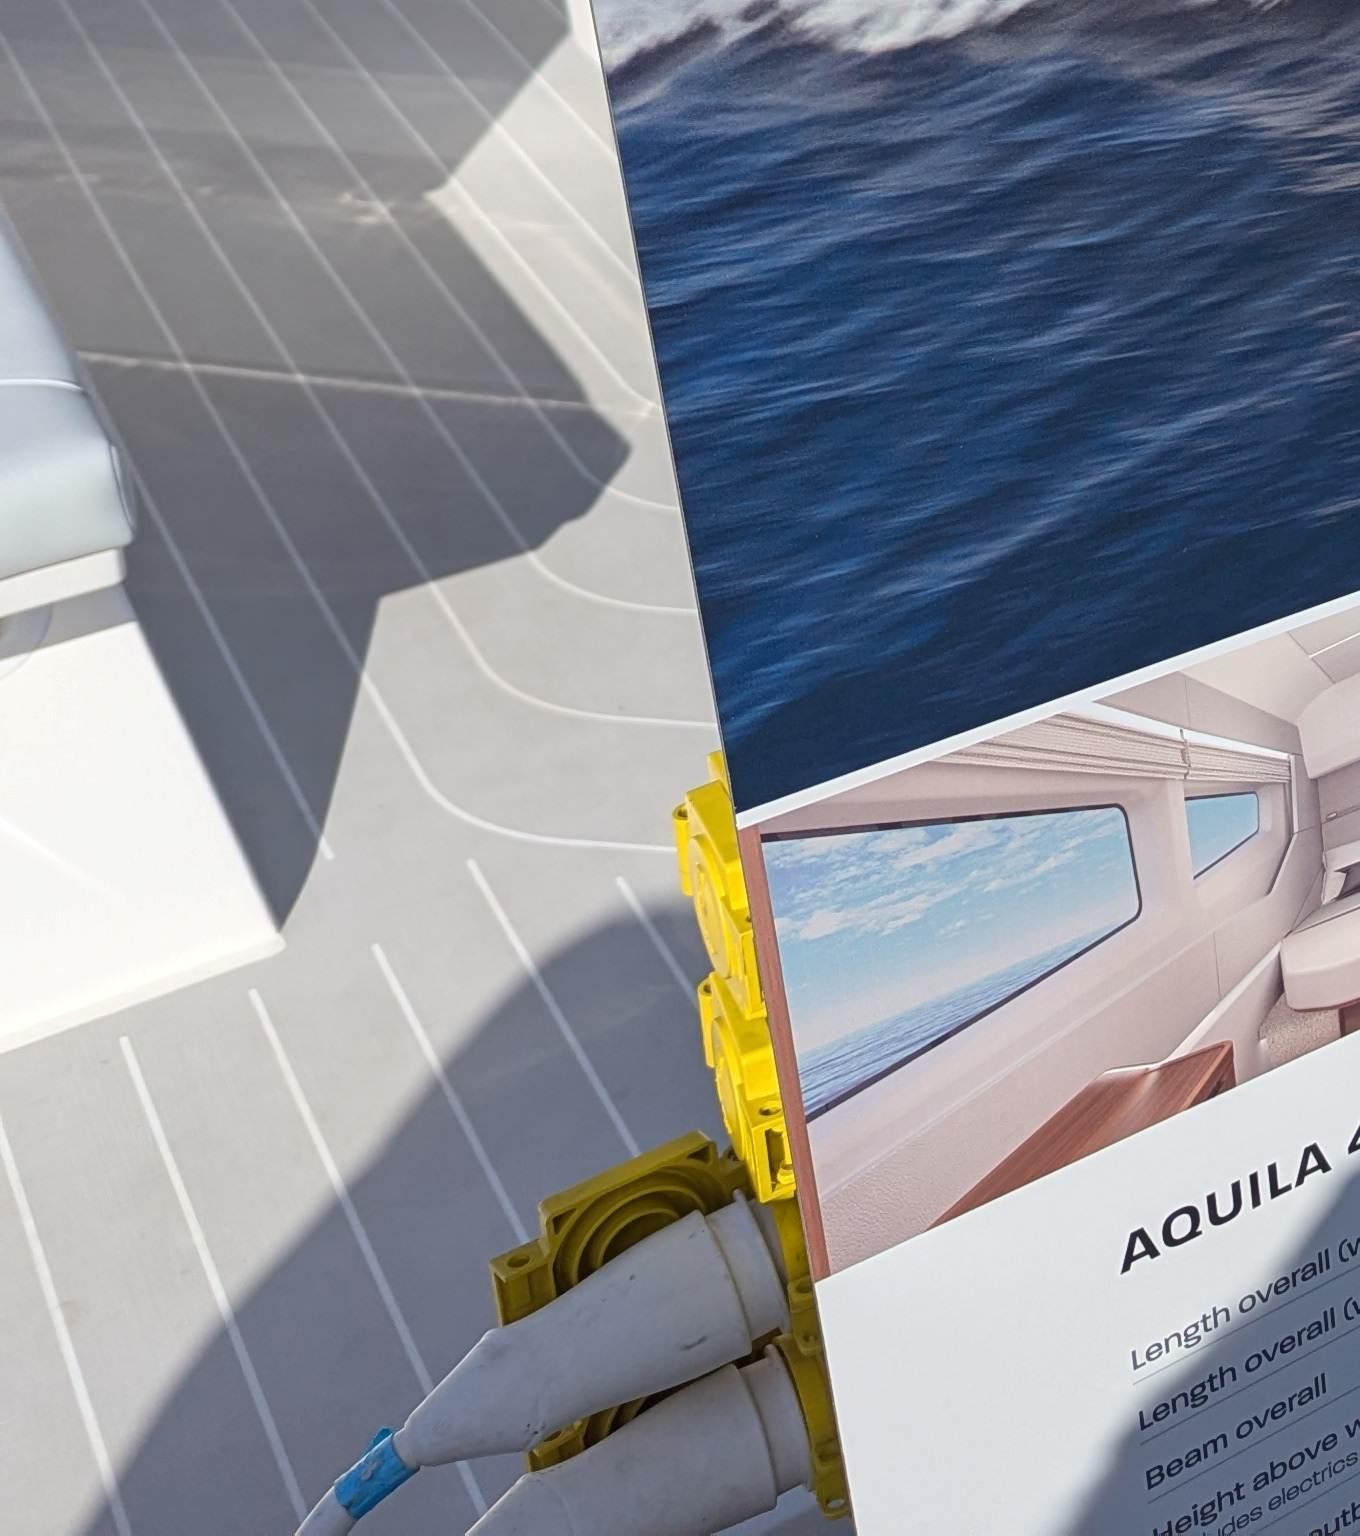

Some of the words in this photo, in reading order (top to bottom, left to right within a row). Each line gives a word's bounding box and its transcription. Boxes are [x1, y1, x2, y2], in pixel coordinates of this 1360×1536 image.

[1120, 1142, 1332, 1275] AQUILA
[1131, 1306, 1231, 1371] Length
[1238, 1248, 1331, 1314] overall
[1138, 1366, 1237, 1432] Length
[1244, 1308, 1336, 1373] overall
[1145, 1433, 1228, 1490] Beam
[1236, 1373, 1327, 1440] overall
[1152, 1482, 1246, 1536] Height
[1253, 1432, 1338, 1491] above
[1267, 1452, 1358, 1514] electrics
